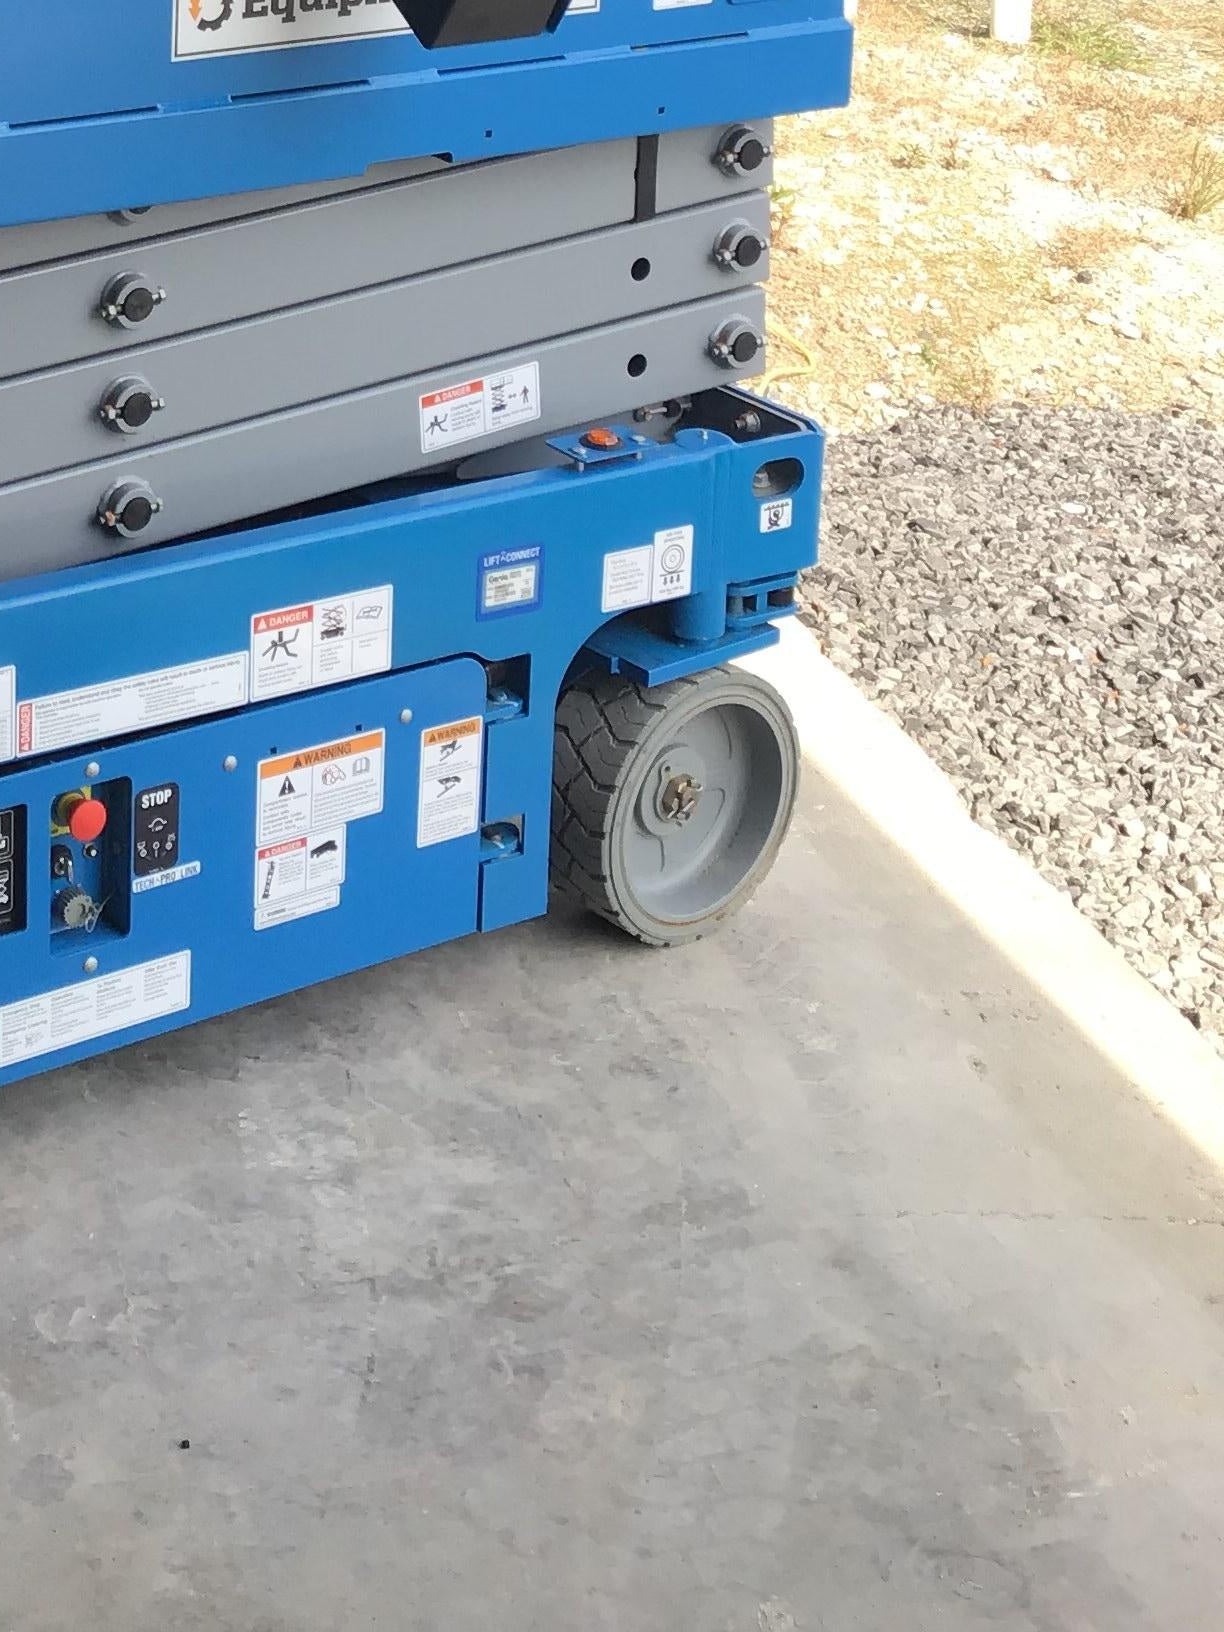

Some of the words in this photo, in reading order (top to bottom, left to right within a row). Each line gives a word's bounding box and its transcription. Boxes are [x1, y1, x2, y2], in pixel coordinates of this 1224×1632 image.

[442, 385, 472, 402] DANGER
[483, 554, 501, 568] LIFT
[505, 546, 541, 563] CONNECT
[268, 610, 309, 628] DANGER
[19, 704, 32, 747] DANGER
[435, 720, 476, 741] WARNING
[304, 741, 353, 767] WARNING
[141, 788, 173, 810] STOP
[271, 840, 303, 856] DANGER
[135, 877, 155, 891] TECH
[161, 871, 177, 885] PRO
